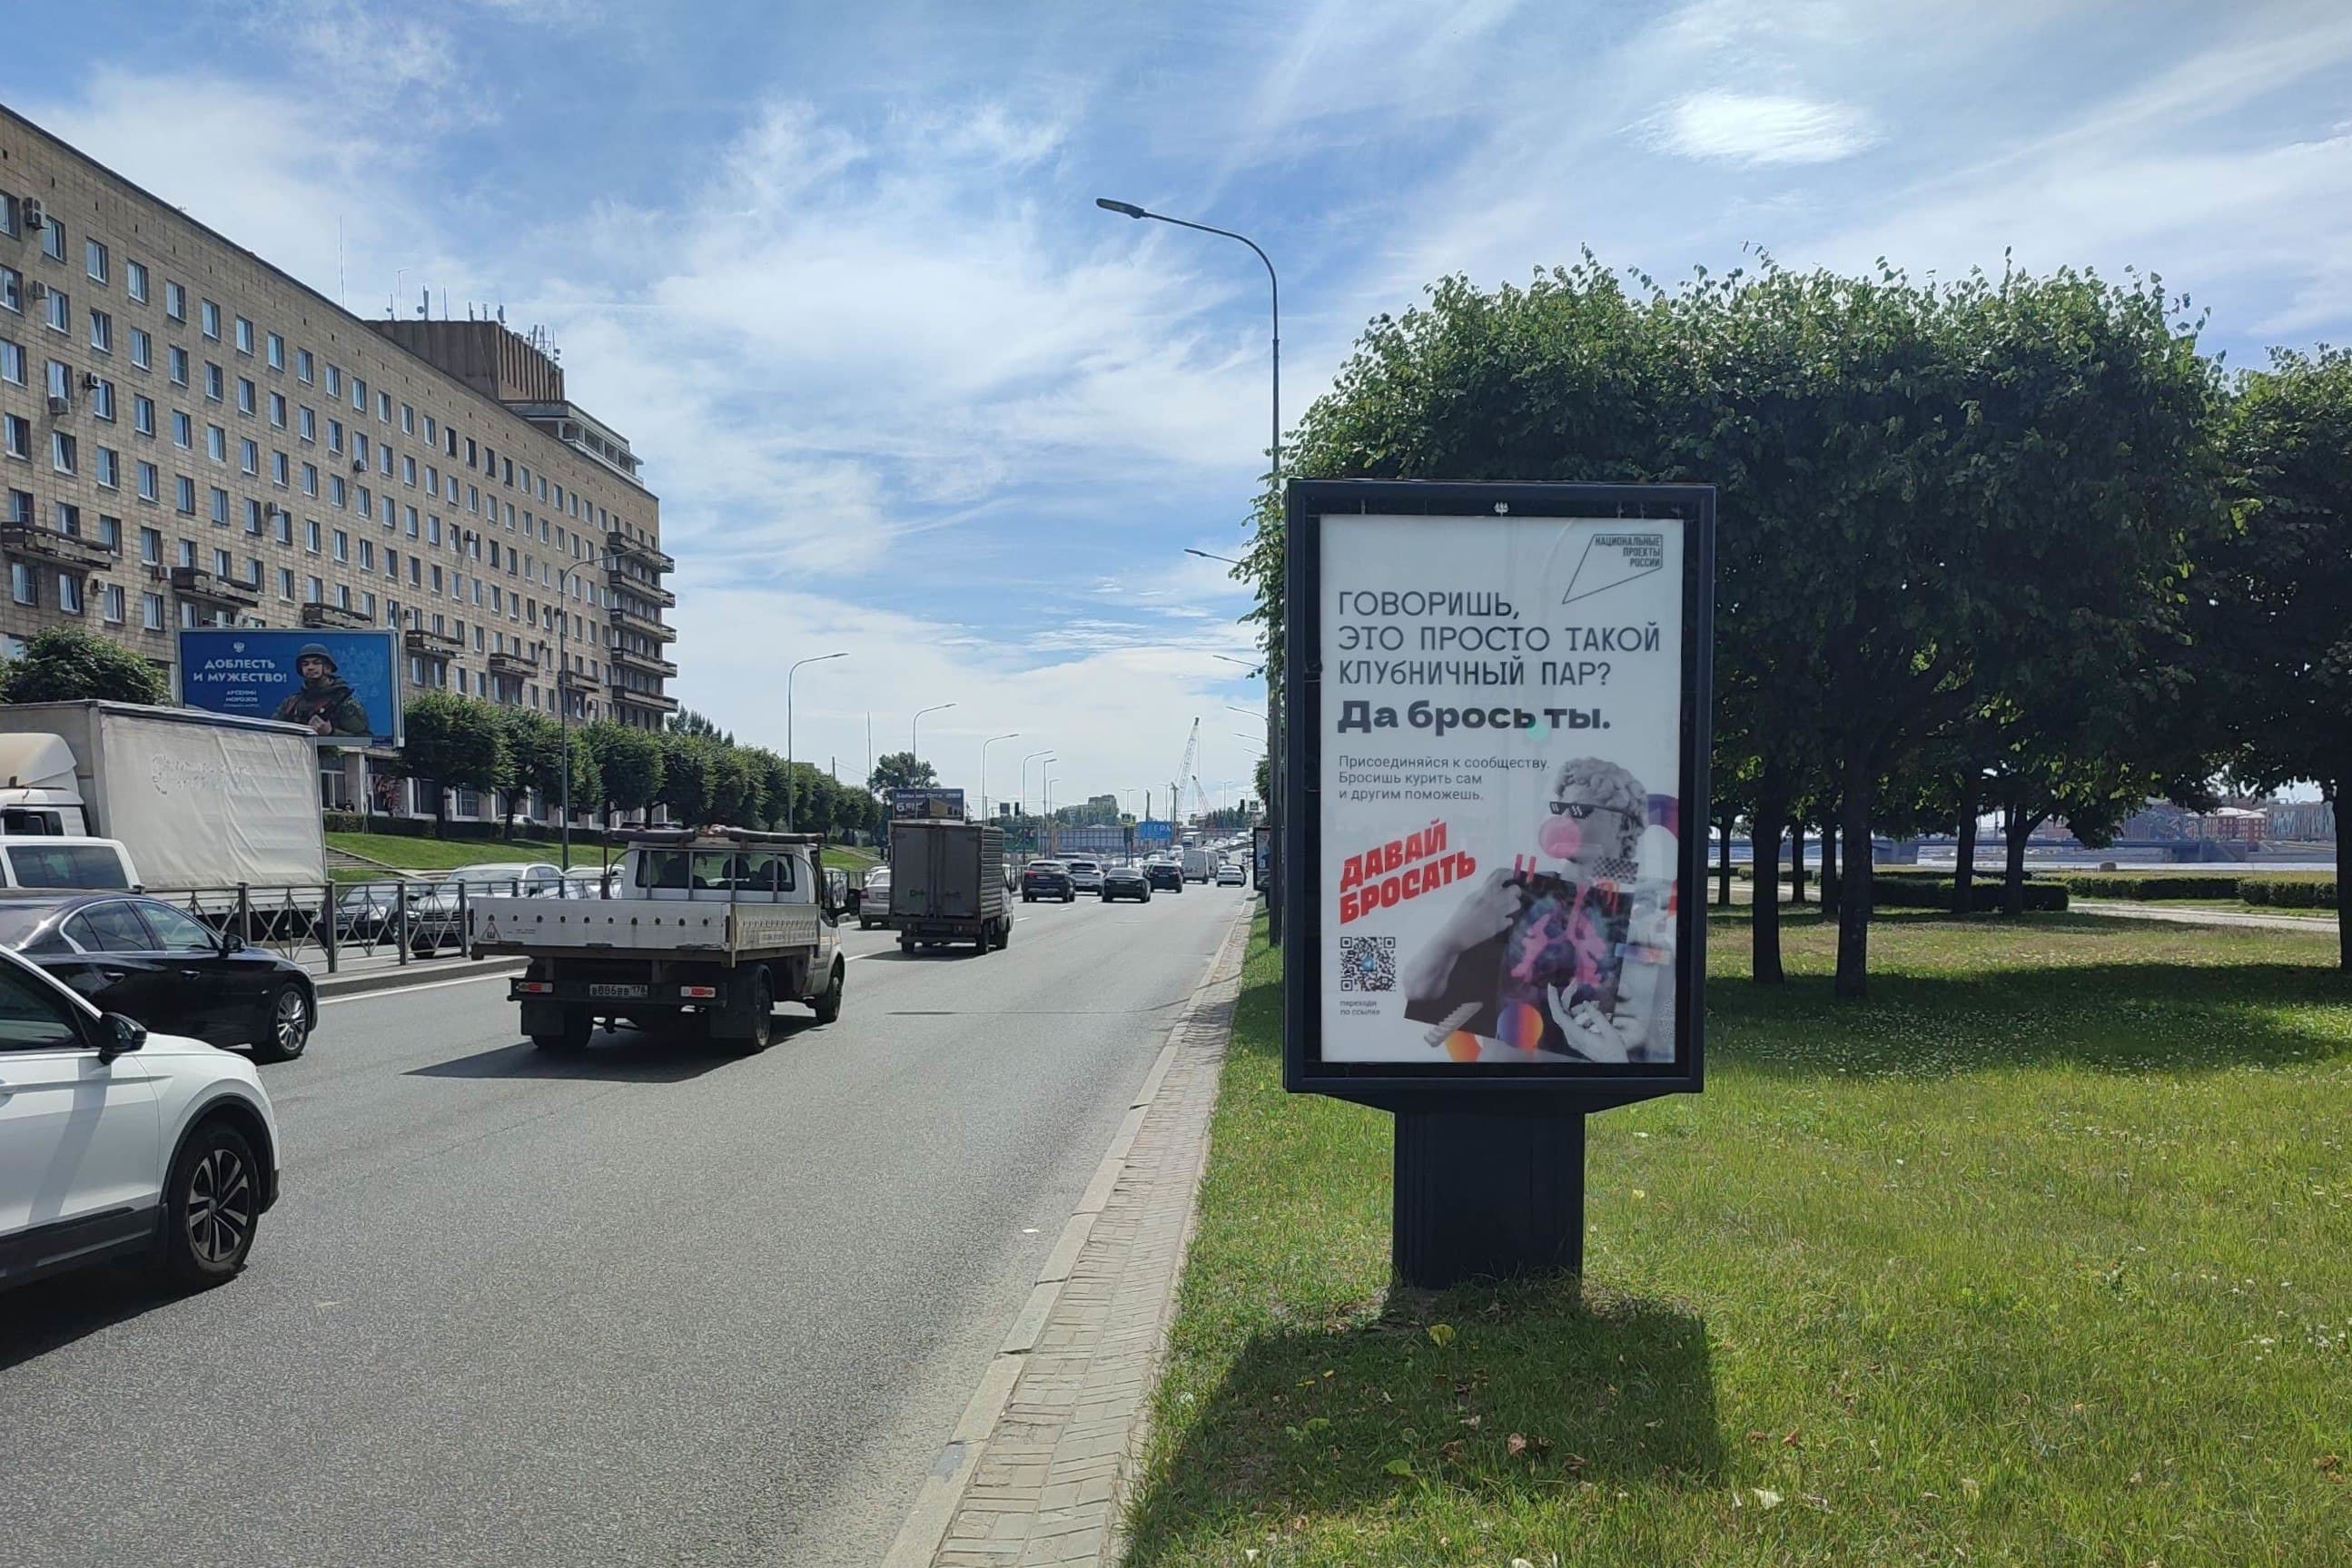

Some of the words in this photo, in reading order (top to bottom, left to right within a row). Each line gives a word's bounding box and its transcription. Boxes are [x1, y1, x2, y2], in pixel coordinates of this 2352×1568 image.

[1596, 537, 1660, 547] НАЦИОНАЛЬНЫЕ
[1623, 547, 1660, 557] ПРОЕКТЫ
[1630, 557, 1660, 567] РОССИИ
[1339, 591, 1519, 620] ГОВОРИШЬ,
[1339, 626, 1404, 651] ЭТО
[1421, 626, 1550, 652] ПРОСТО
[1566, 621, 1660, 652] ТАКОЙ
[204, 659, 275, 669] ДОБЛЕСТЬ
[193, 673, 203, 682] И
[208, 673, 287, 683] МУЖЕСТВО!
[1542, 661, 1611, 685] ПАР?
[1338, 700, 1398, 734] Да
[1408, 700, 1538, 736] брось
[1545, 708, 1610, 729] ты.
[1339, 755, 1448, 772] Присоединяйся
[1453, 759, 1460, 768] к
[1465, 756, 1549, 773] сообществу.
[1339, 771, 1401, 787] Бросишь
[1405, 774, 1452, 788] курить
[1456, 775, 1482, 784] сам
[1339, 791, 1347, 799] и
[1351, 789, 1400, 803] другим
[1405, 791, 1483, 800] поможешь.
[1340, 817, 1447, 893] ДАВАЙ
[1340, 851, 1477, 924] БРОСАТЬ
